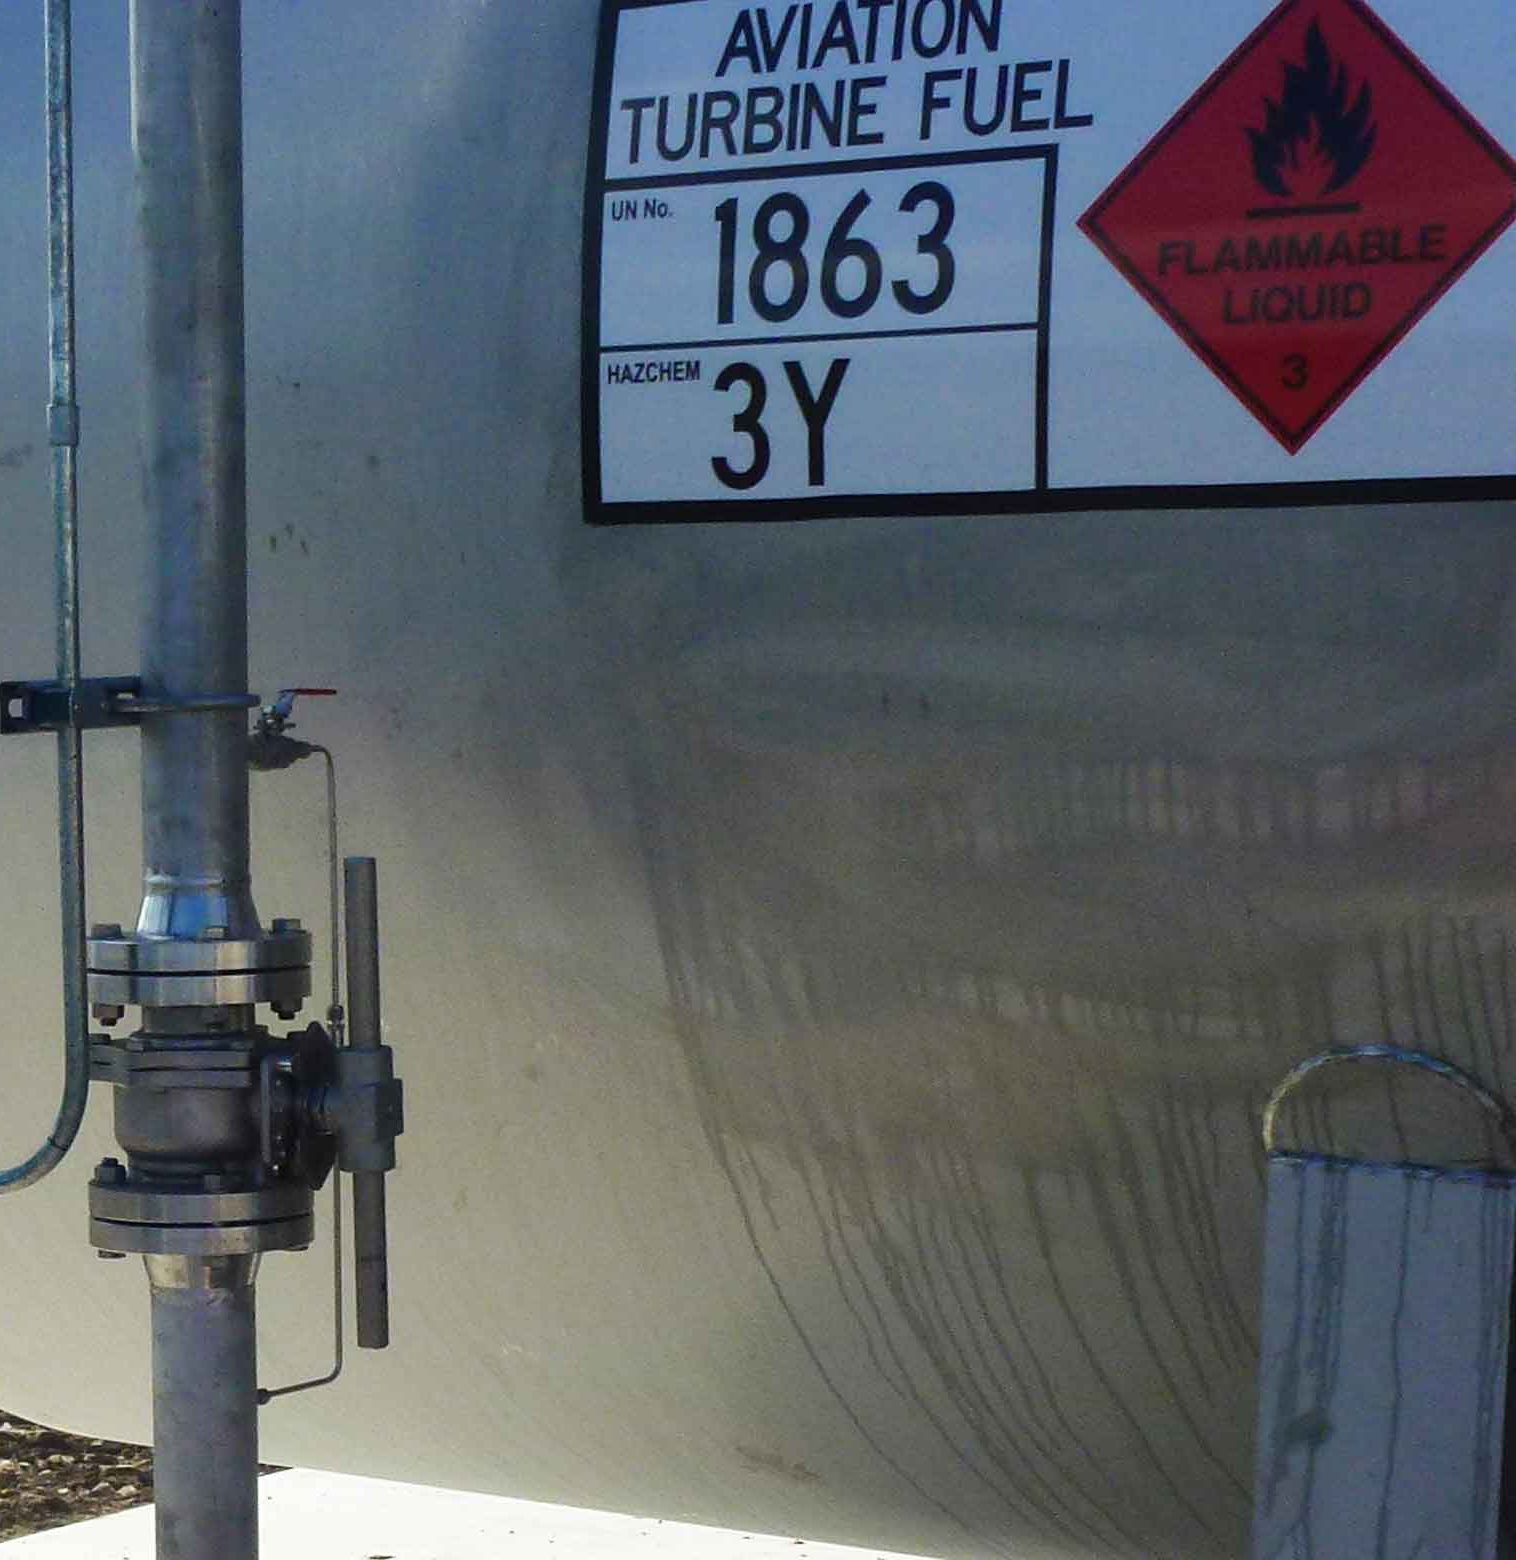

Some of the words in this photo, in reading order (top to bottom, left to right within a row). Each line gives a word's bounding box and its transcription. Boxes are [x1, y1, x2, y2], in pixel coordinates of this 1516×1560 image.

[715, 0, 1004, 77] AVIATION
[620, 75, 888, 164] TURBINE
[919, 58, 1095, 141] FUEL
[611, 201, 637, 221] UN
[643, 198, 674, 219] No.
[714, 181, 956, 326] 1863
[1156, 224, 1447, 277] FLAMMABLE
[1222, 282, 1372, 325] LIQUID
[607, 359, 702, 385] HAZCHEM
[1281, 353, 1308, 389] 3
[710, 357, 852, 491] 3Y
